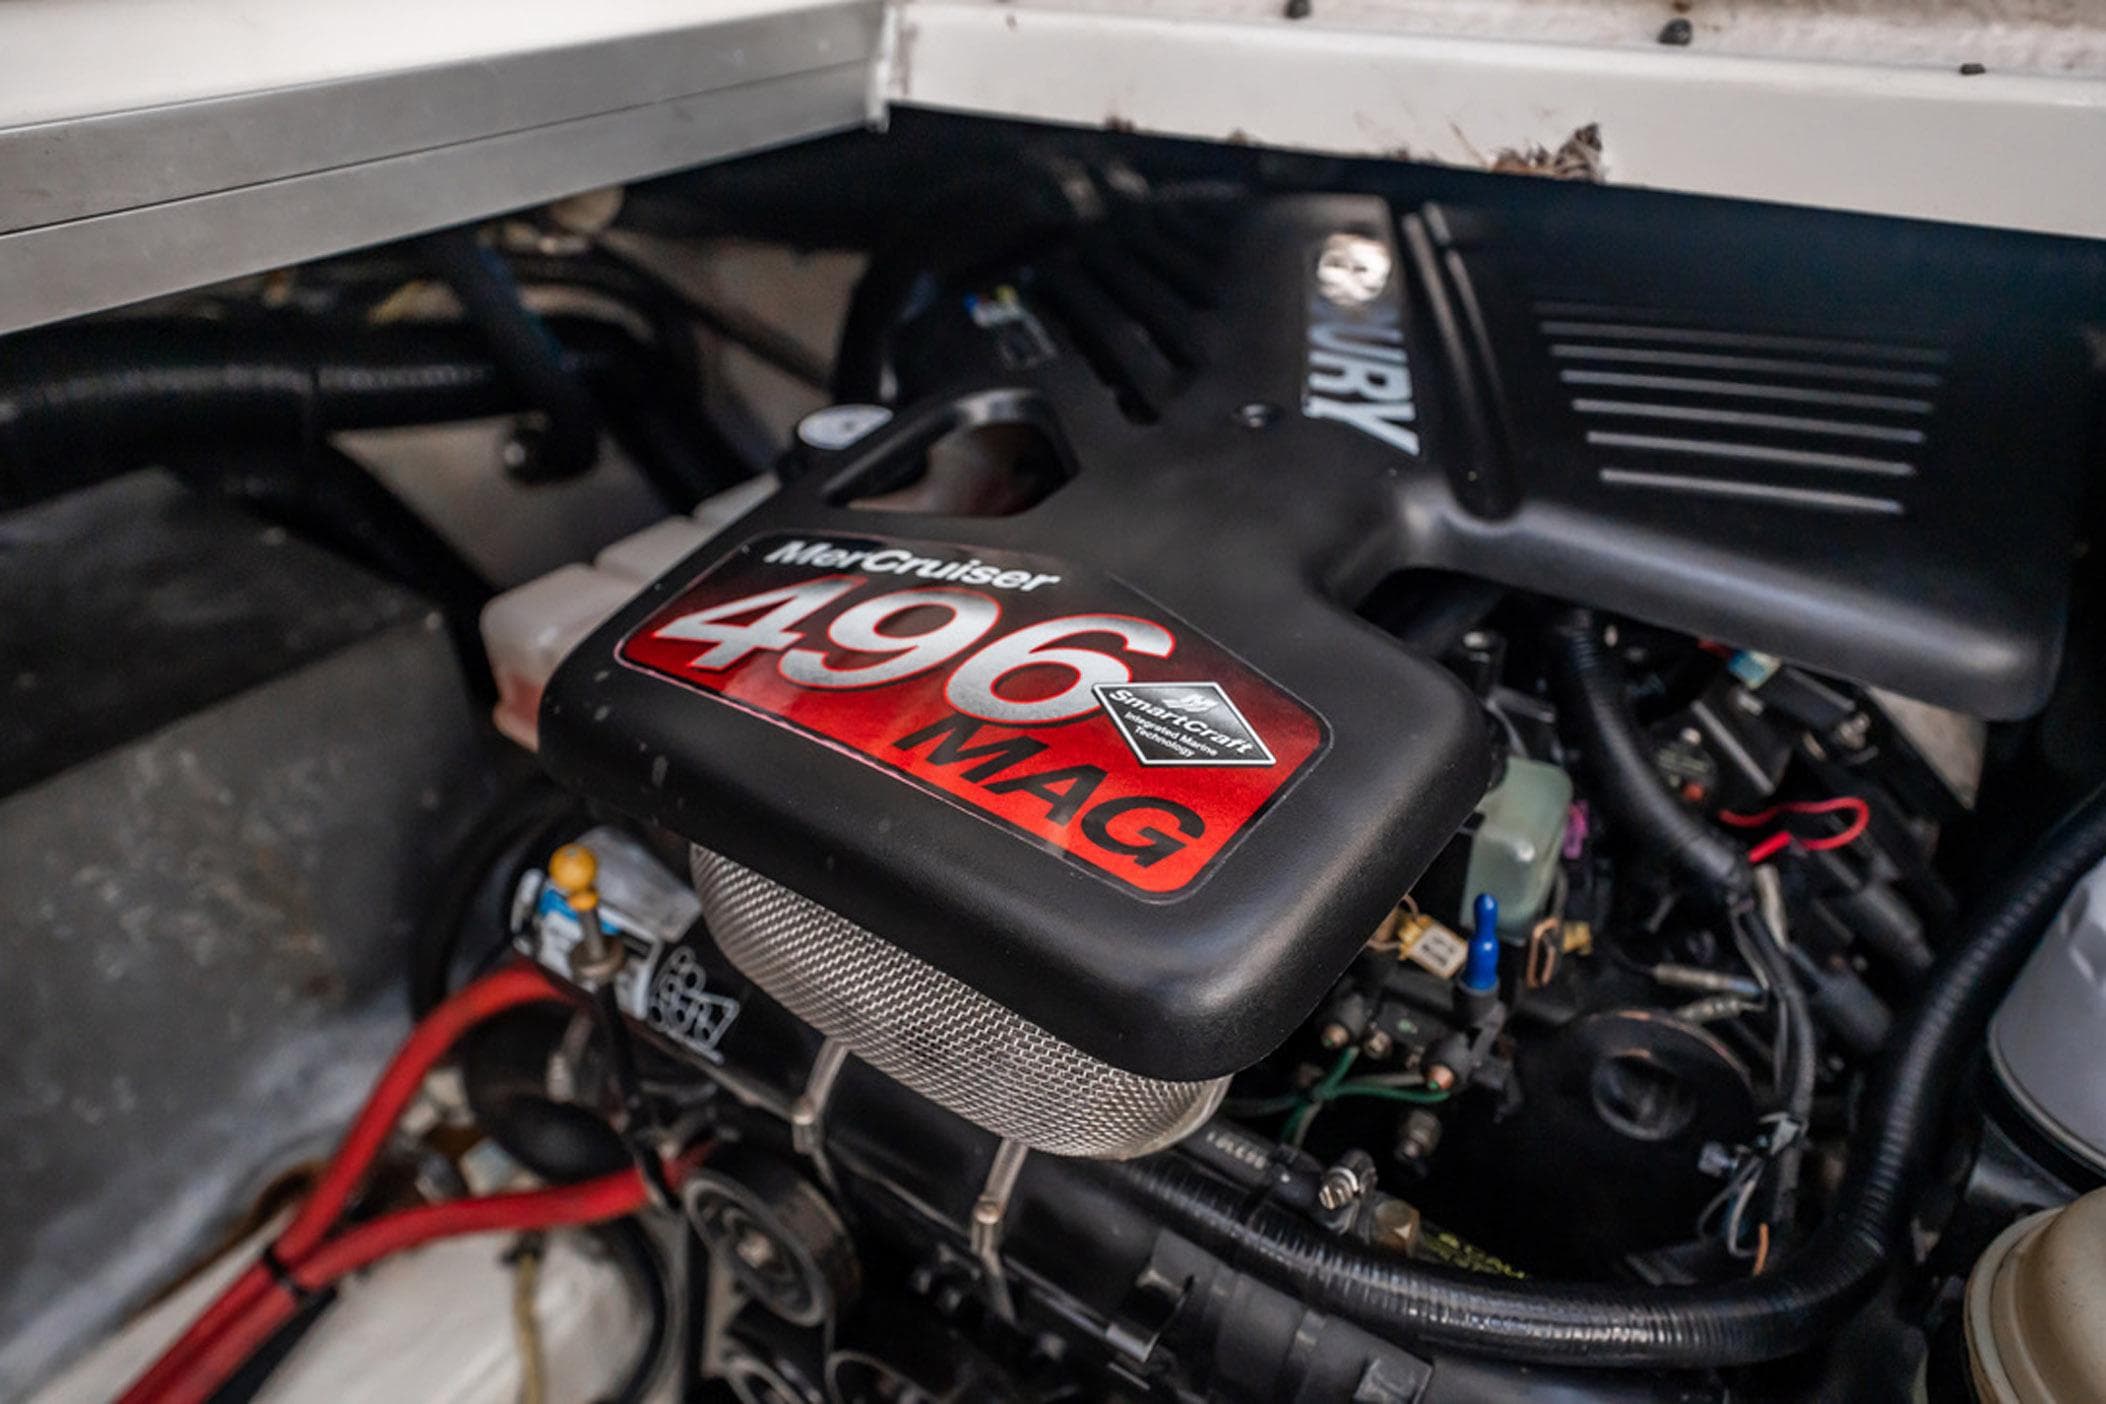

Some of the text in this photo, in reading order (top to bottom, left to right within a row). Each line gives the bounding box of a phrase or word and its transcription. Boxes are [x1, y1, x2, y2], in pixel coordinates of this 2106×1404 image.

[764, 541, 1061, 591] MerCruiser
[652, 574, 1176, 726] 496
[1109, 689, 1252, 754] SmartCraft
[1123, 711, 1220, 757] Integrated Marine
[1133, 725, 1196, 759] Technology
[892, 714, 1206, 868] MAG
